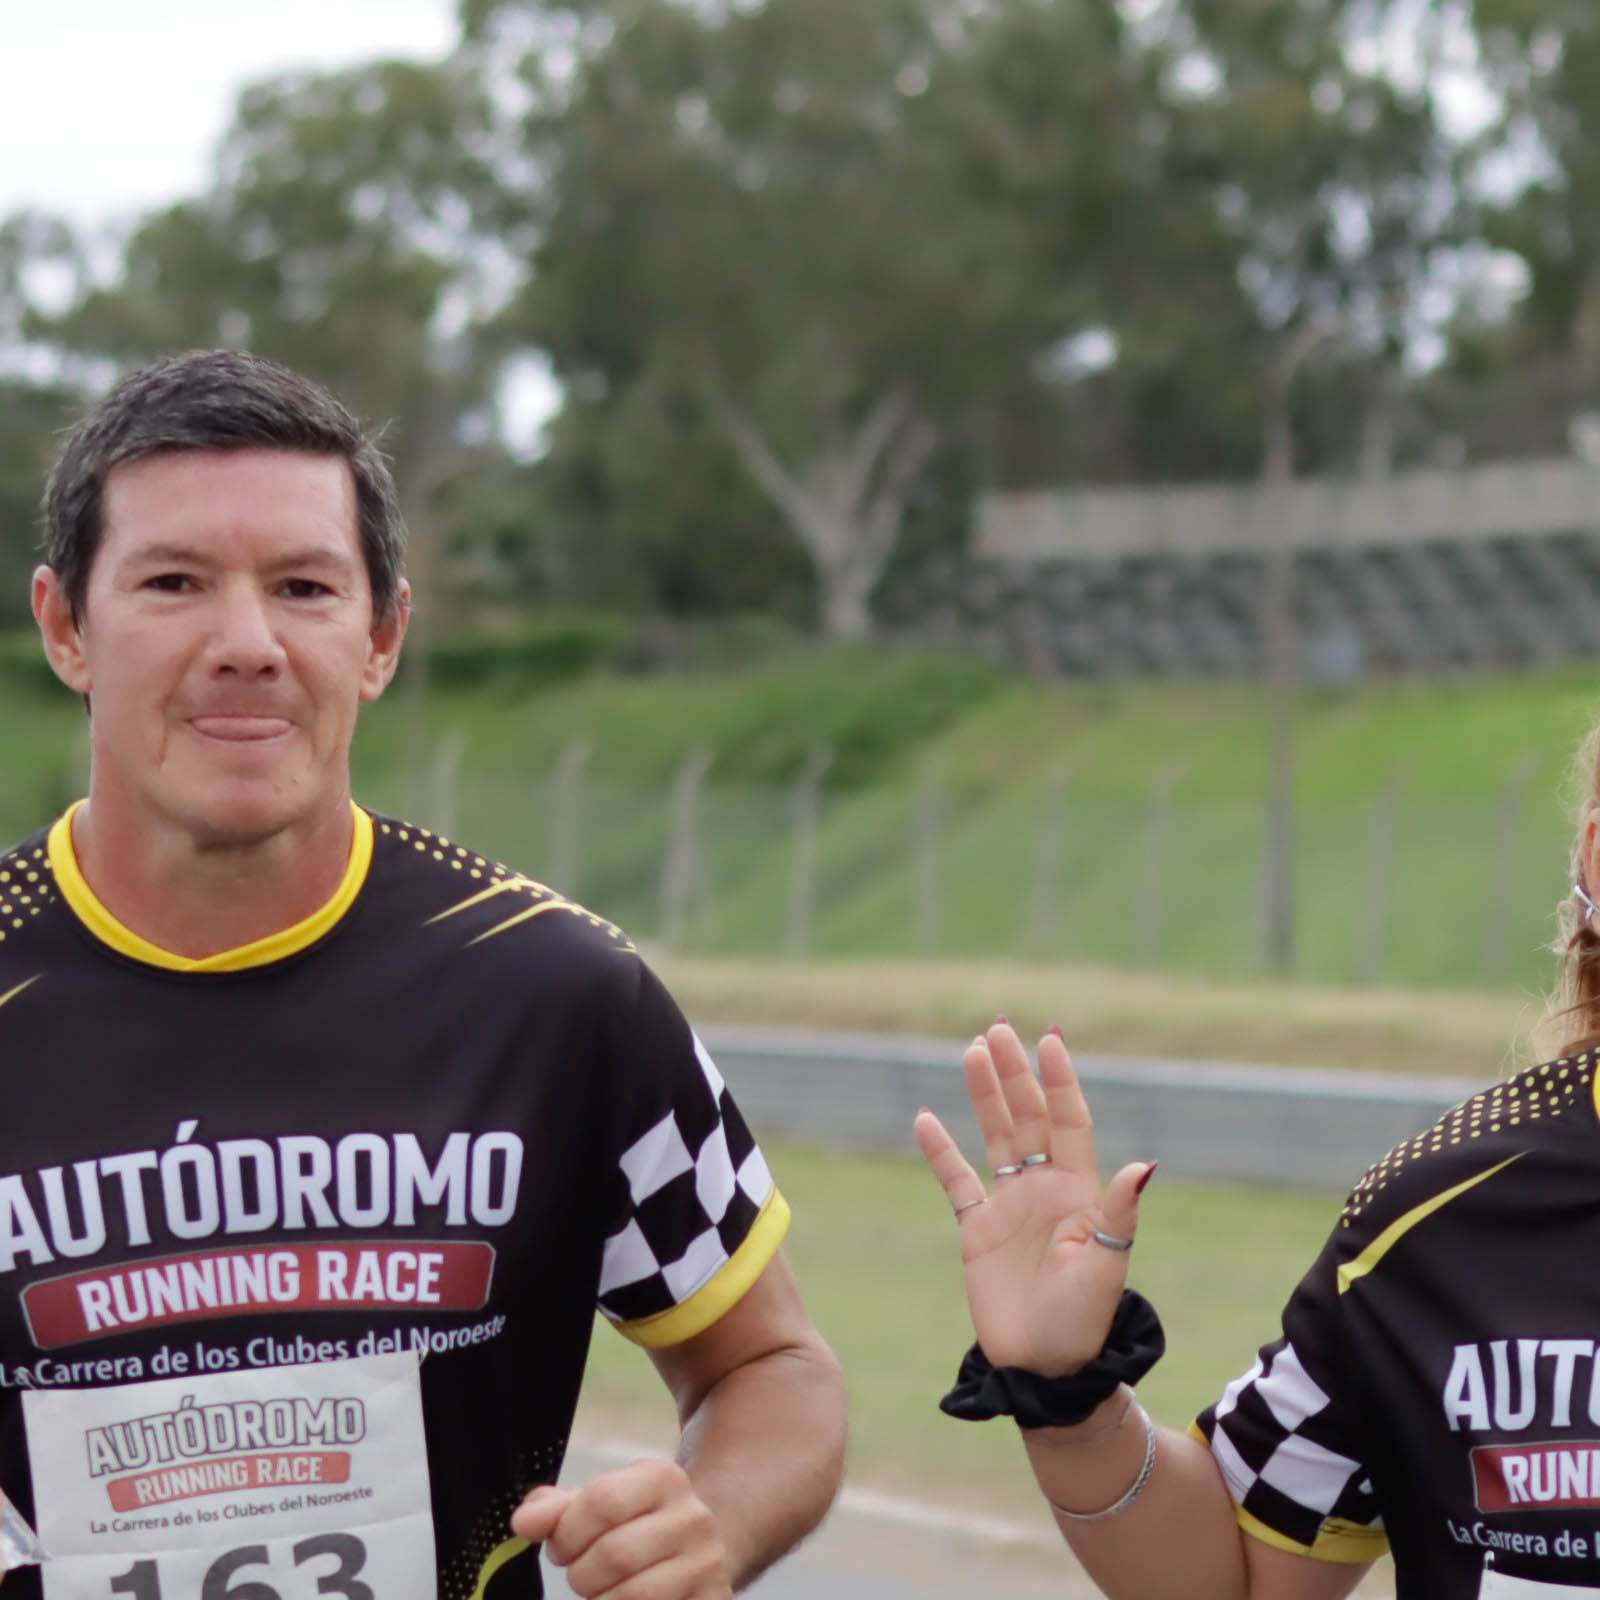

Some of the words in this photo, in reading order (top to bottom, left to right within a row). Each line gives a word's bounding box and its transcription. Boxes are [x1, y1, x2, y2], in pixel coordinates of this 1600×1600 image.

[76, 1252, 300, 1332] RUNNING
[316, 1251, 444, 1302] RACE
[34, 1356, 143, 1385] Carrera
[151, 1346, 189, 1374] de
[196, 1342, 240, 1369] los
[247, 1334, 349, 1366] Clubes
[356, 1328, 401, 1357] del
[85, 1395, 364, 1477] AUTÓDROMO
[134, 1461, 248, 1505] RUNNING
[256, 1457, 322, 1485] RACE
[91, 1521, 108, 1534] La
[112, 1515, 169, 1533] Carrera
[173, 1510, 193, 1526] de
[198, 1508, 219, 1523] los
[223, 1501, 275, 1519] Clubes
[280, 1497, 302, 1512] del
[307, 1486, 373, 1508] Noroeste
[1448, 1520, 1472, 1543] La
[1474, 1522, 1548, 1556] Carrera
[1555, 1531, 1587, 1558] de
